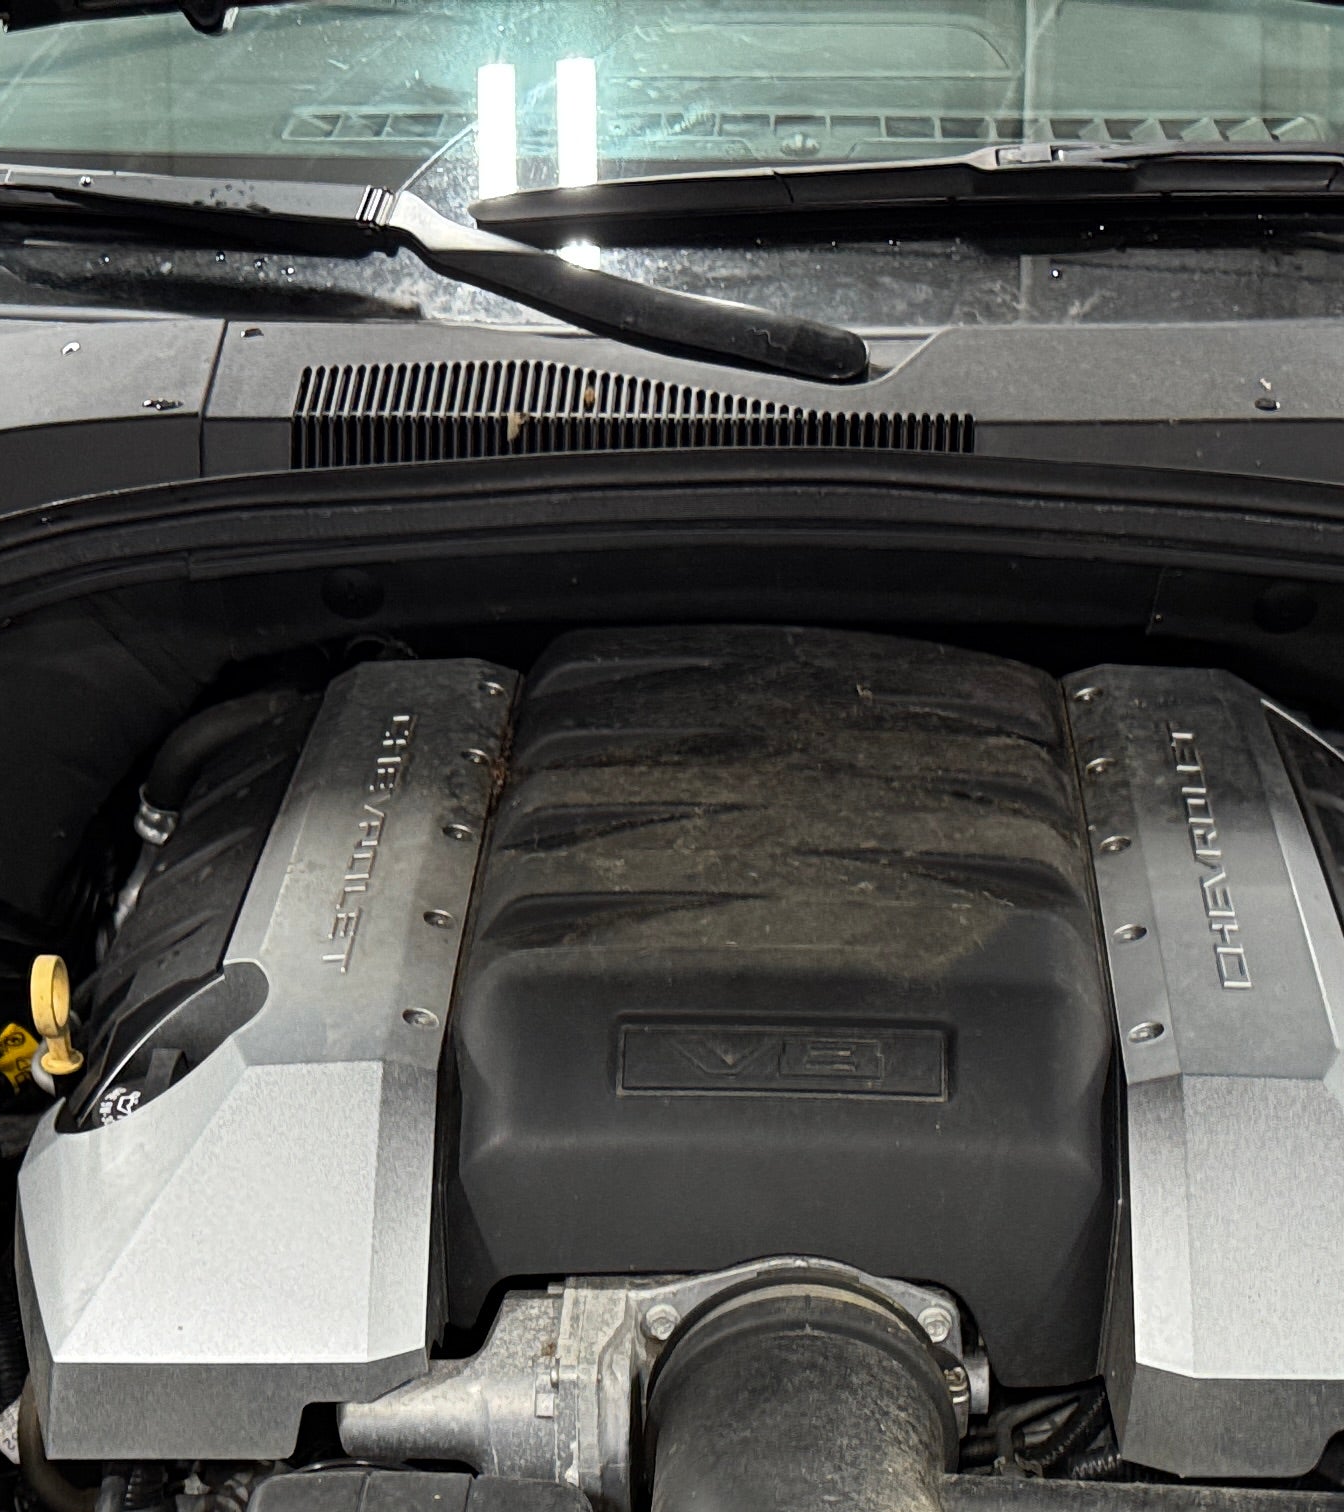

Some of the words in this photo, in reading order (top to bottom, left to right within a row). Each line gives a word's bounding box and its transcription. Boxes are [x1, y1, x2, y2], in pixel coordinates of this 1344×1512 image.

[321, 714, 418, 975] CHEVROLET
[1166, 721, 1253, 990] CHEVROLET
[664, 1033, 887, 1083] V8
